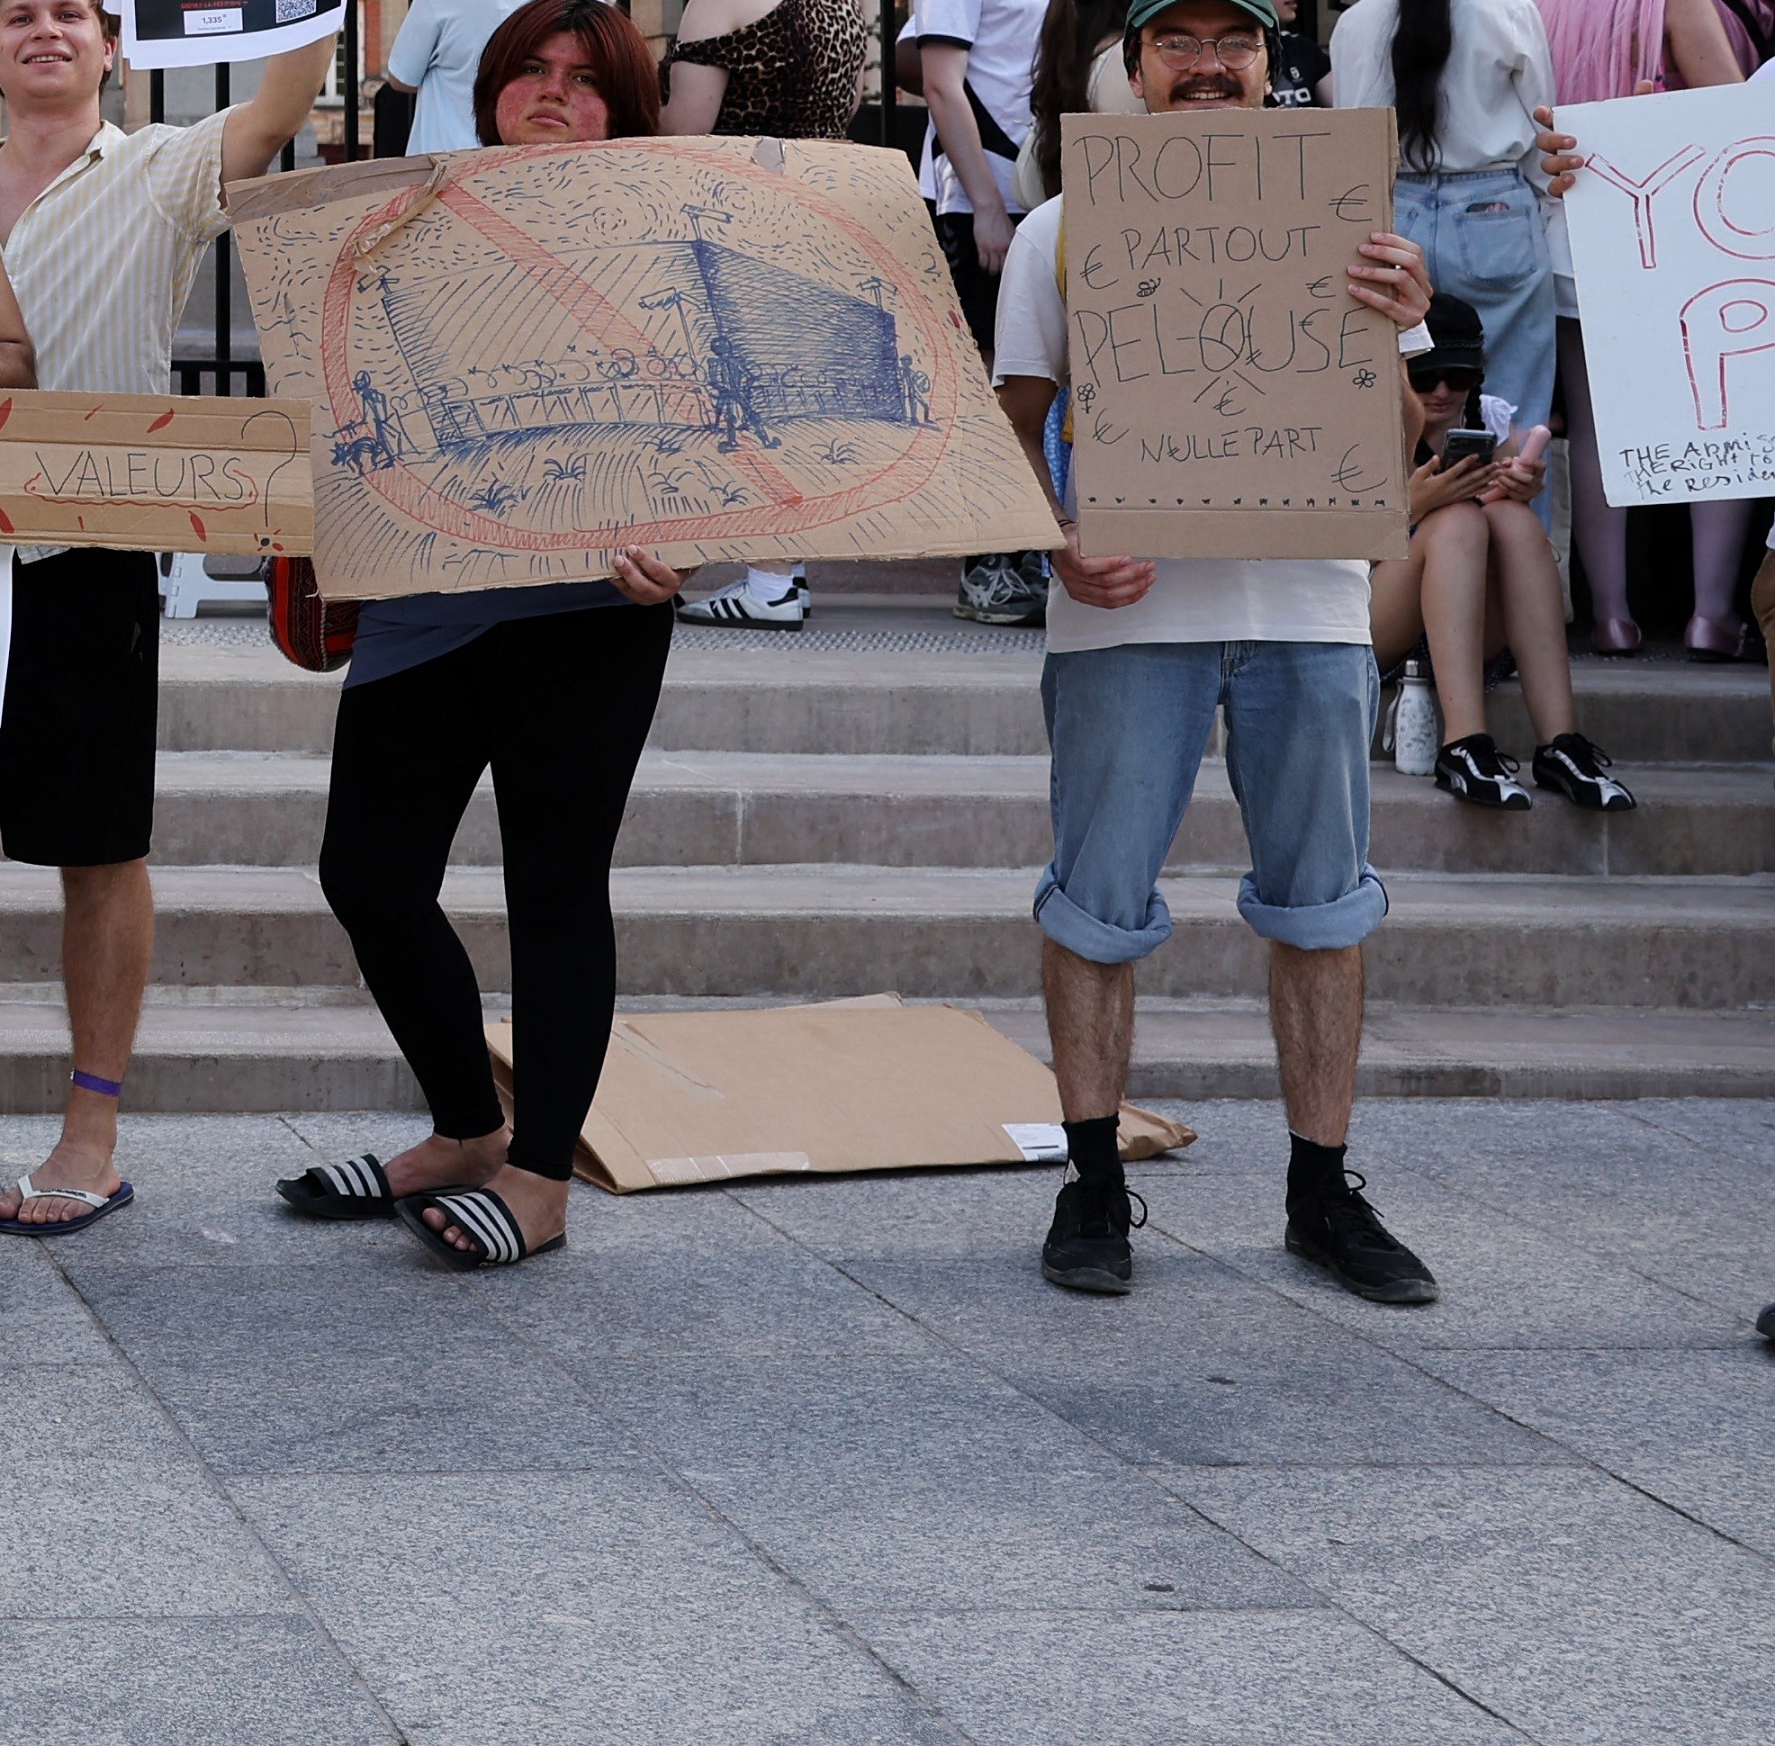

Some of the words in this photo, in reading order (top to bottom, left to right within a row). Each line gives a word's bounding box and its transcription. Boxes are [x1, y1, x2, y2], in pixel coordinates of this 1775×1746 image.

[202, 16, 222, 24] 1,335
[1072, 132, 1331, 206] PROFIT
[1120, 225, 1322, 271] PARTOUT
[1244, 426, 1324, 460] PART
[1619, 443, 1670, 467] THE
[34, 449, 245, 502] VALEURS
[1623, 461, 1667, 482] THE
